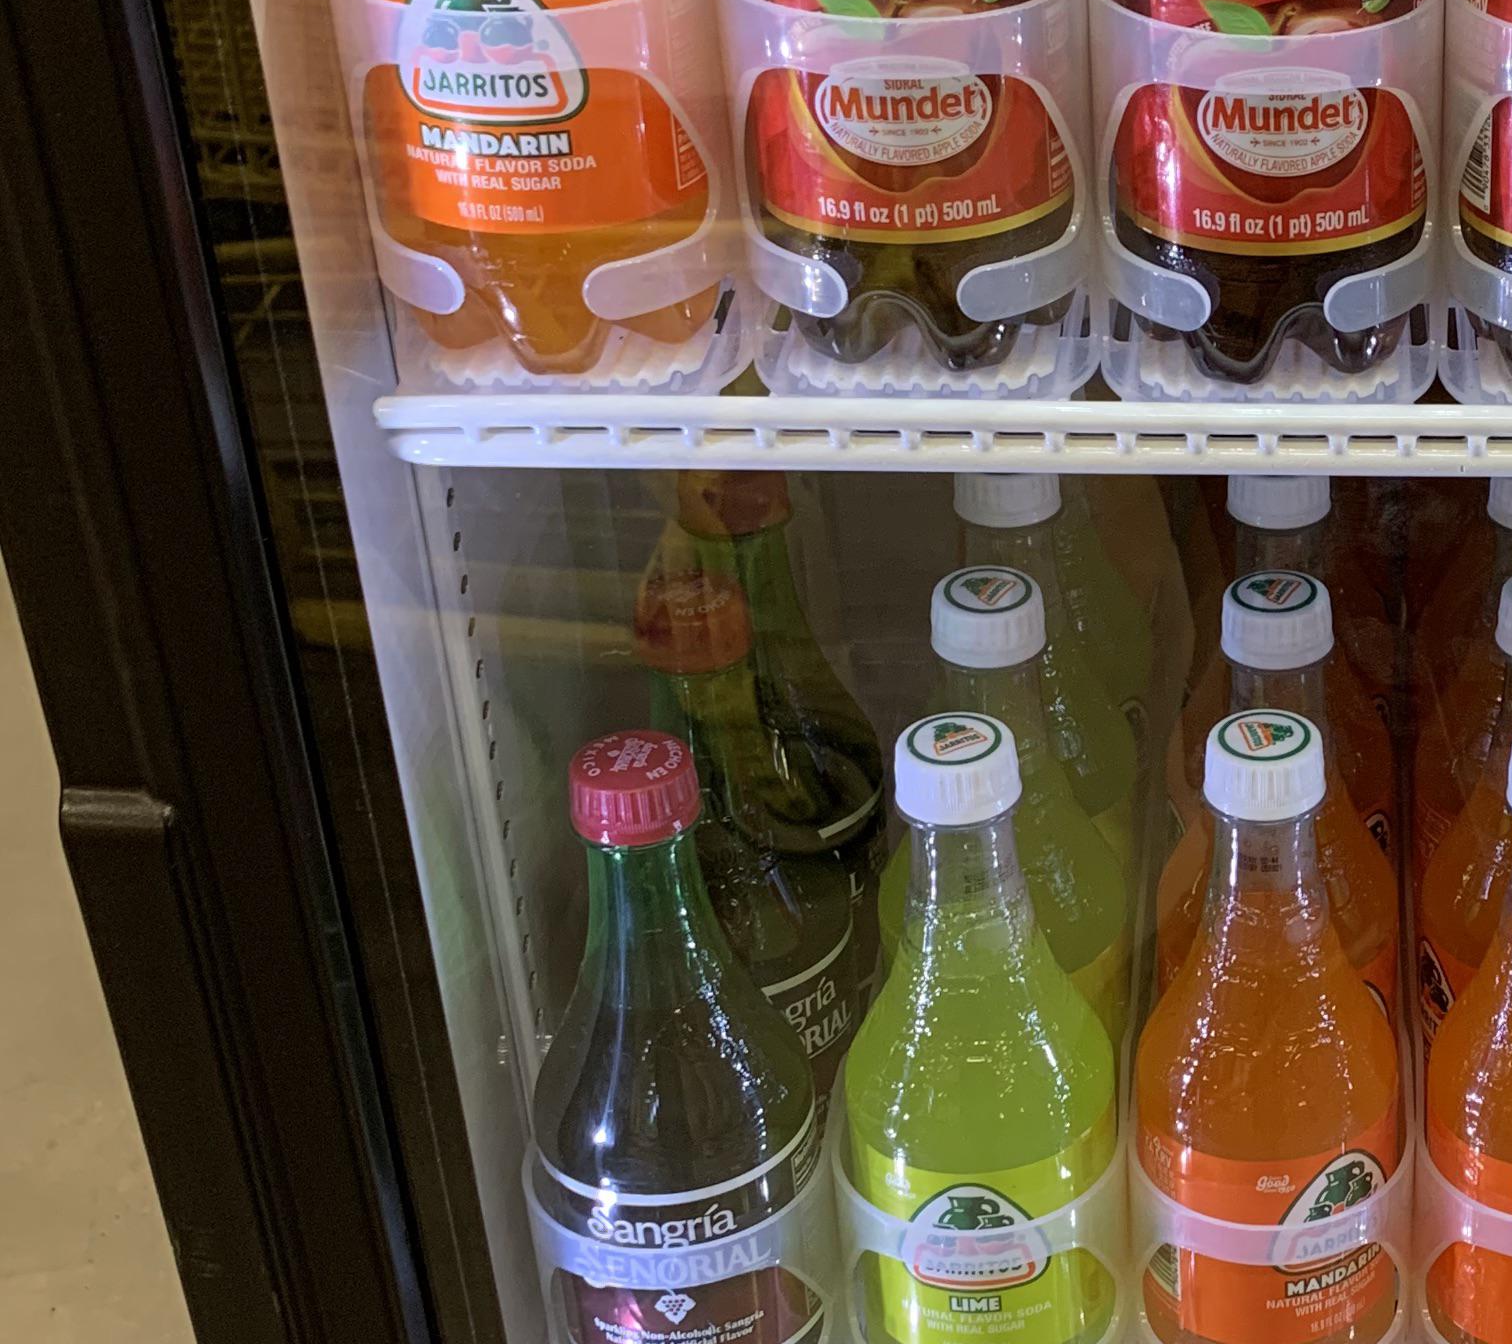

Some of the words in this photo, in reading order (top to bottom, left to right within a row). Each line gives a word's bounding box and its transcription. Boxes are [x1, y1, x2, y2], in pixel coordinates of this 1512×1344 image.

[423, 66, 549, 99] JARRITOS
[829, 83, 976, 123] Mundet
[1211, 94, 1355, 133] Mundet
[420, 123, 572, 156] MANDARIN
[830, 120, 878, 158] NATURALLY
[880, 147, 930, 161] FLAVORED
[932, 134, 962, 160] APPLE
[1210, 133, 1258, 169] NATURALLY
[1260, 158, 1308, 172] FLAVORED
[1310, 147, 1337, 168] APPLE
[435, 169, 468, 187] WITH
[472, 175, 508, 191] REAL
[512, 175, 561, 191] SUGAR
[475, 158, 542, 174] FLAVOR
[548, 155, 597, 173] SODA
[818, 196, 850, 219] 16.9
[870, 206, 889, 225] oz
[893, 203, 908, 228] (1
[915, 202, 938, 228] pt)
[942, 198, 973, 220] 500
[977, 195, 1001, 218] mL
[1192, 208, 1224, 230] 16.9
[1245, 218, 1264, 236] oz
[1268, 216, 1283, 239] (1
[1289, 213, 1312, 239] pt)
[1315, 209, 1345, 230] 500
[1348, 205, 1370, 226] mL
[785, 976, 837, 1034] gría
[1255, 1174, 1290, 1193] good
[586, 1204, 738, 1249] Sangría
[1285, 1242, 1382, 1297] MANDARIN
[950, 1296, 1001, 1312] LIME
[1017, 1301, 1052, 1319] SODA
[1266, 1289, 1325, 1310] NATURAL
[1295, 1302, 1322, 1317] WITH
[1324, 1291, 1349, 1309] REAL
[720, 1325, 754, 1344] Flavor
